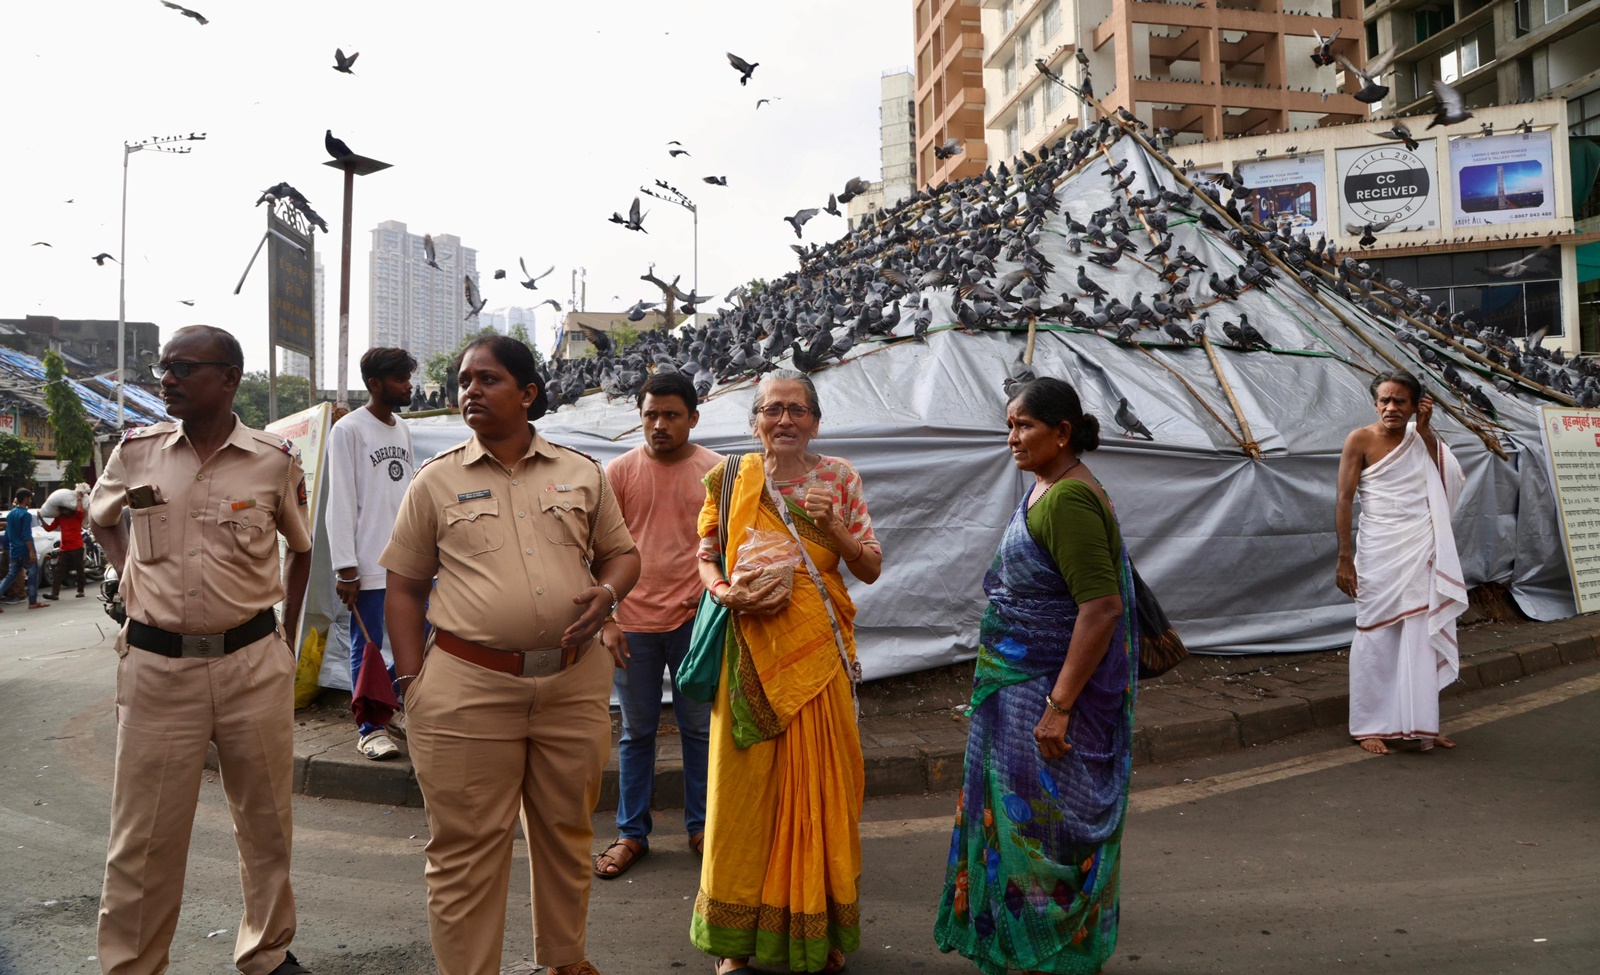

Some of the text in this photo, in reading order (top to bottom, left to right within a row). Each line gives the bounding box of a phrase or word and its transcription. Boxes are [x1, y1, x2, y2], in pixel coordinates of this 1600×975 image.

[1355, 151, 1385, 170] TILL
[1376, 174, 1396, 184] CC
[1356, 185, 1418, 200] RECEIVED
[1364, 205, 1413, 222] FLOOR
[1562, 411, 1590, 431] बृहन्मुंबई
